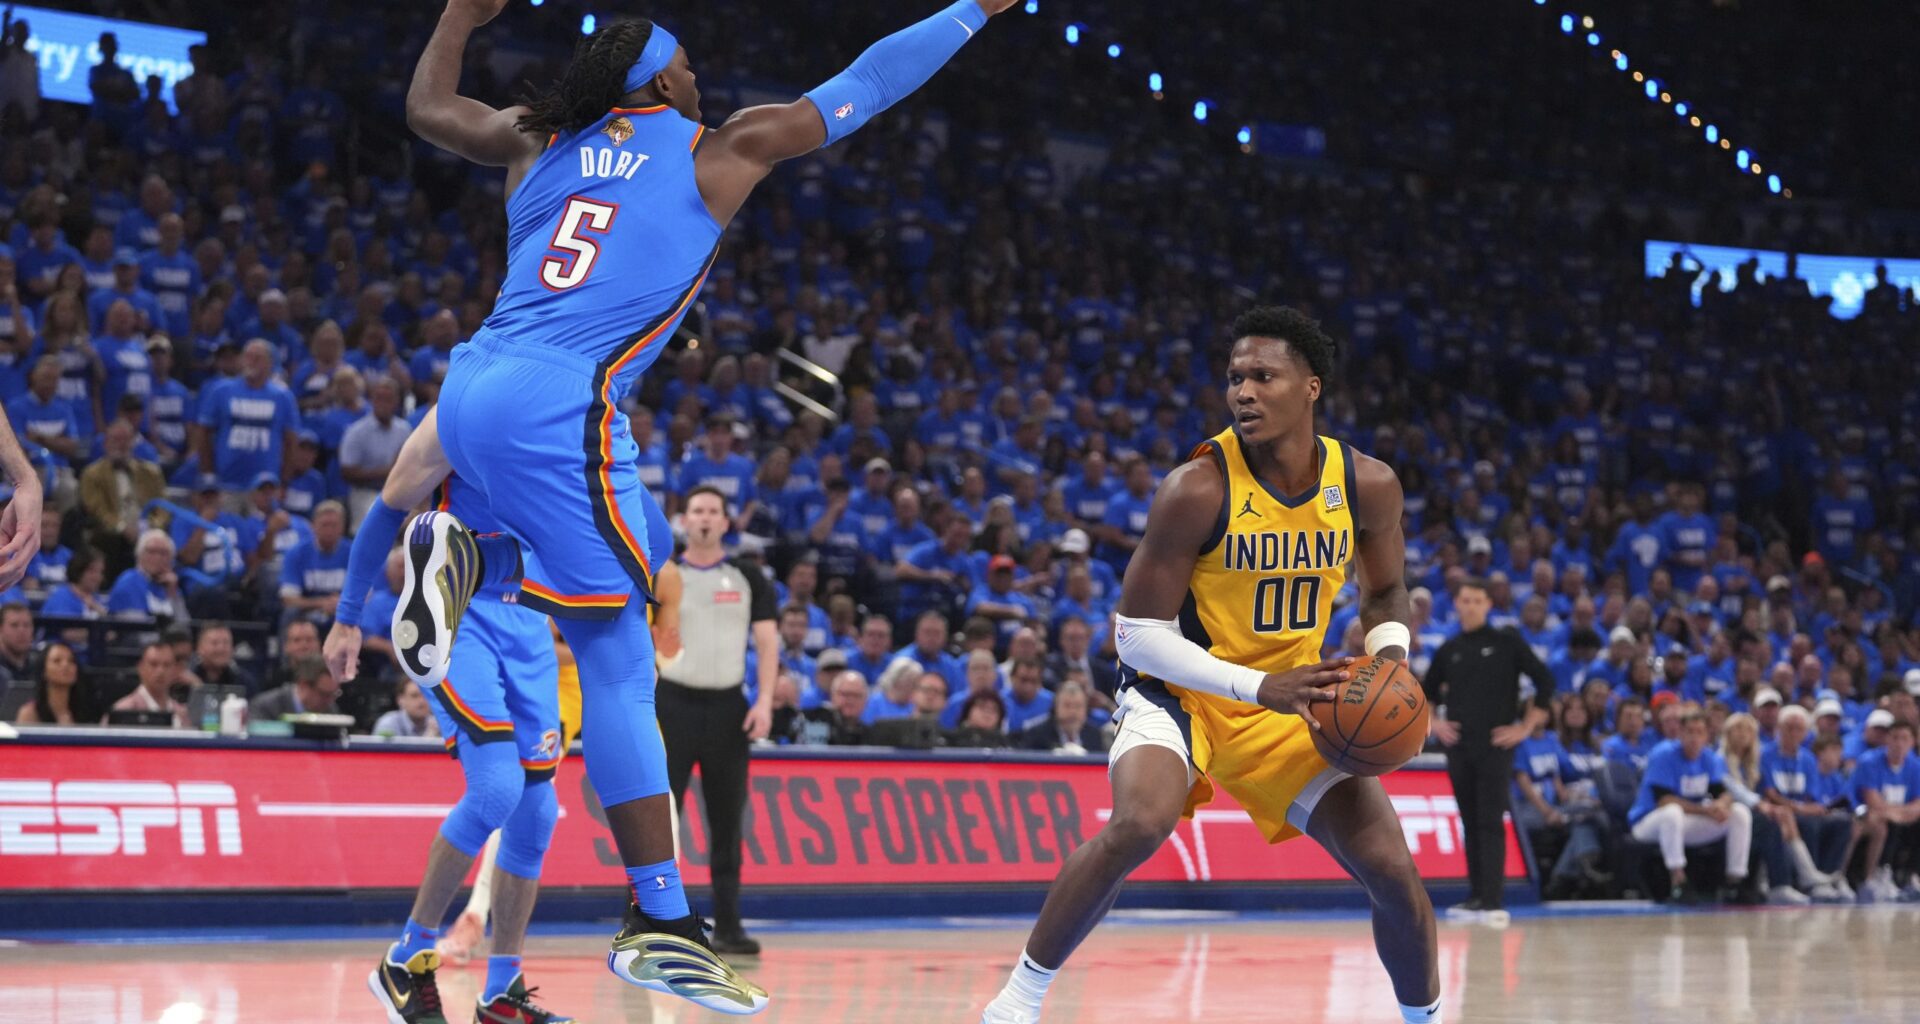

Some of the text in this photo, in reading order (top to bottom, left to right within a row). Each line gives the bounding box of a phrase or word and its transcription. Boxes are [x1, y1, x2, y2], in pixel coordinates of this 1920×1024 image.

[601, 119, 635, 134] Finals
[580, 146, 650, 180] DORT
[538, 194, 620, 293] 5
[1224, 528, 1349, 571] INDIANA
[1253, 575, 1321, 634] 00
[0, 779, 243, 856] ESPN
[835, 777, 1086, 865] FOREVER
